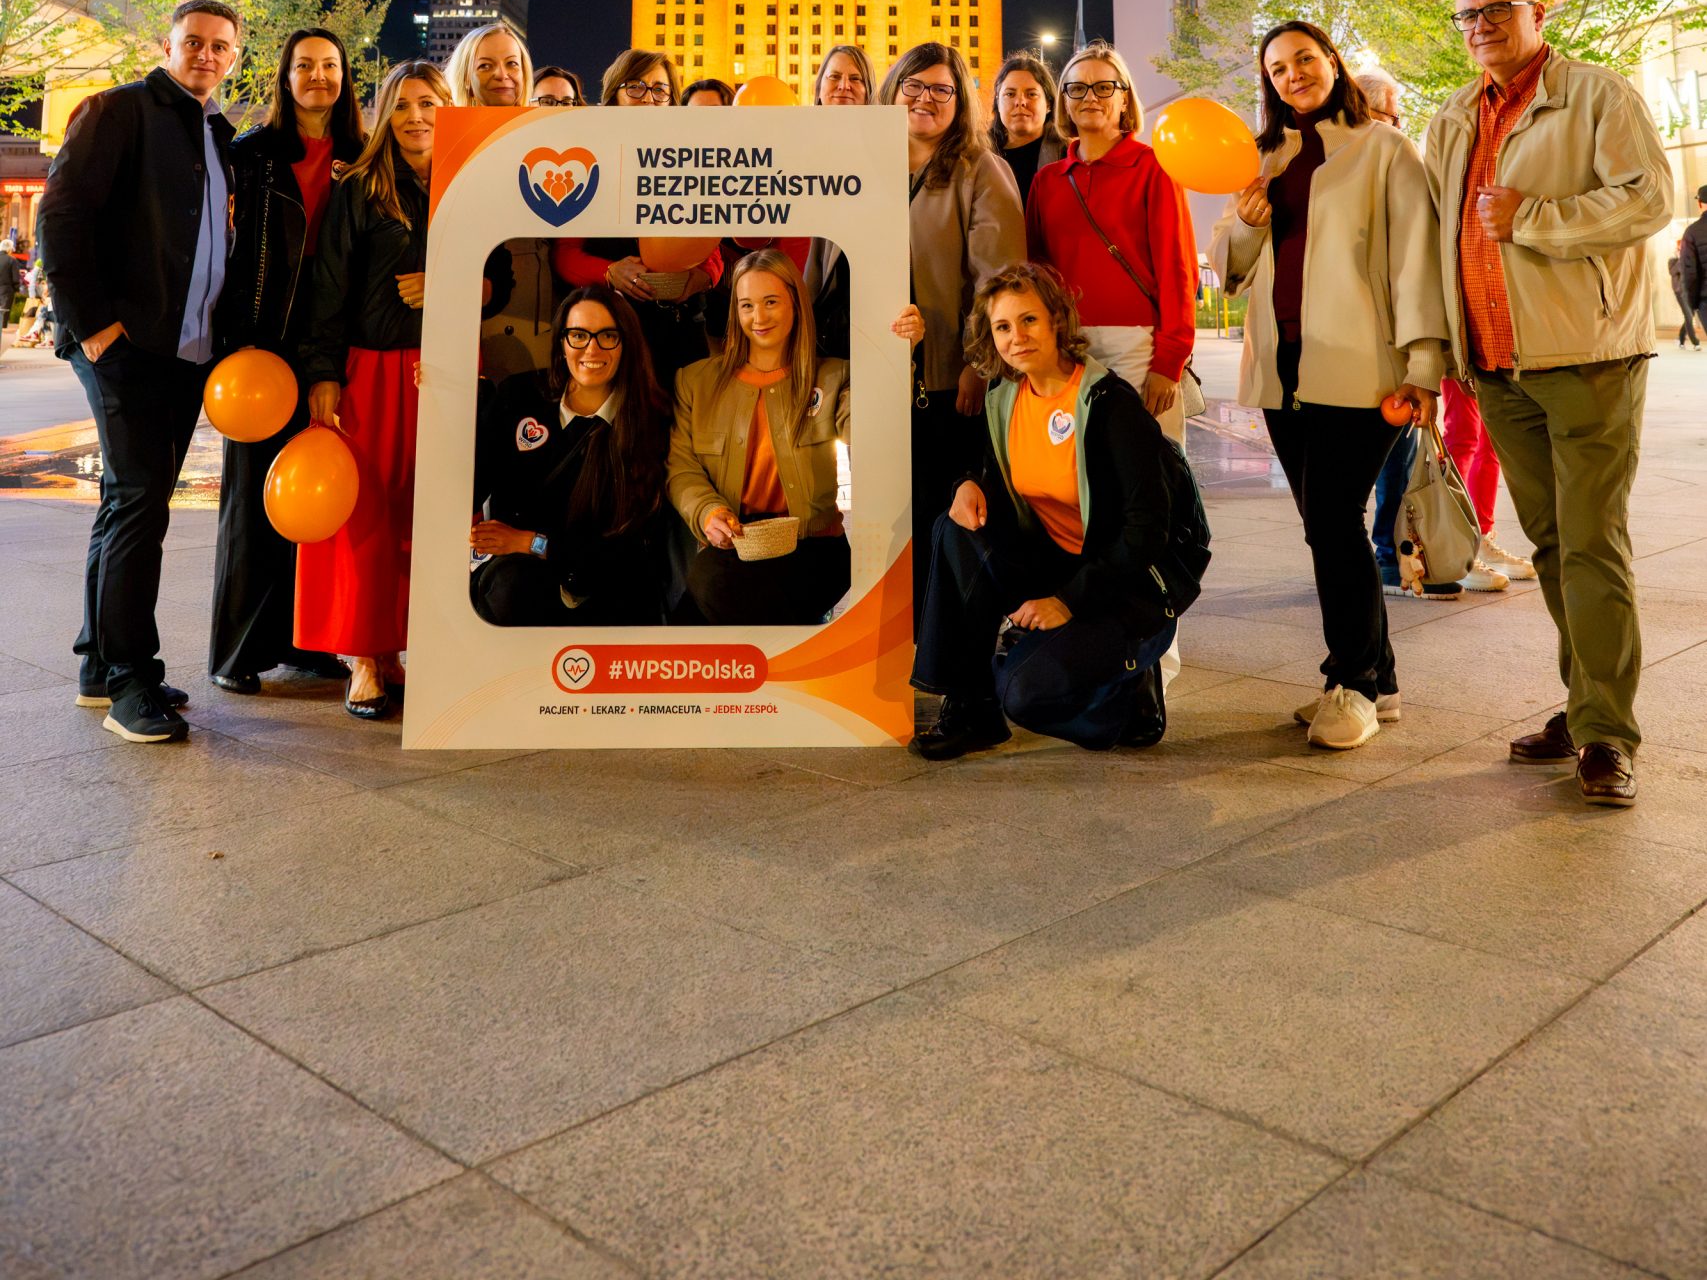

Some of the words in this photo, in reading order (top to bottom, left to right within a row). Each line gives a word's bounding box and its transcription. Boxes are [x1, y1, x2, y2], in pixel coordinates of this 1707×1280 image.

[636, 147, 773, 169] WSPIERAM
[636, 169, 862, 197] BEZPIECZEŃSTWO
[635, 198, 791, 225] PACJENTÓW
[608, 658, 756, 681] #WPSDPolska
[539, 705, 580, 715] PACJENT
[591, 705, 626, 715] LEKARZ
[638, 705, 702, 714] FARMACEUTA
[713, 705, 742, 714] JEDEN
[744, 703, 779, 714] ZESPÓŁ
